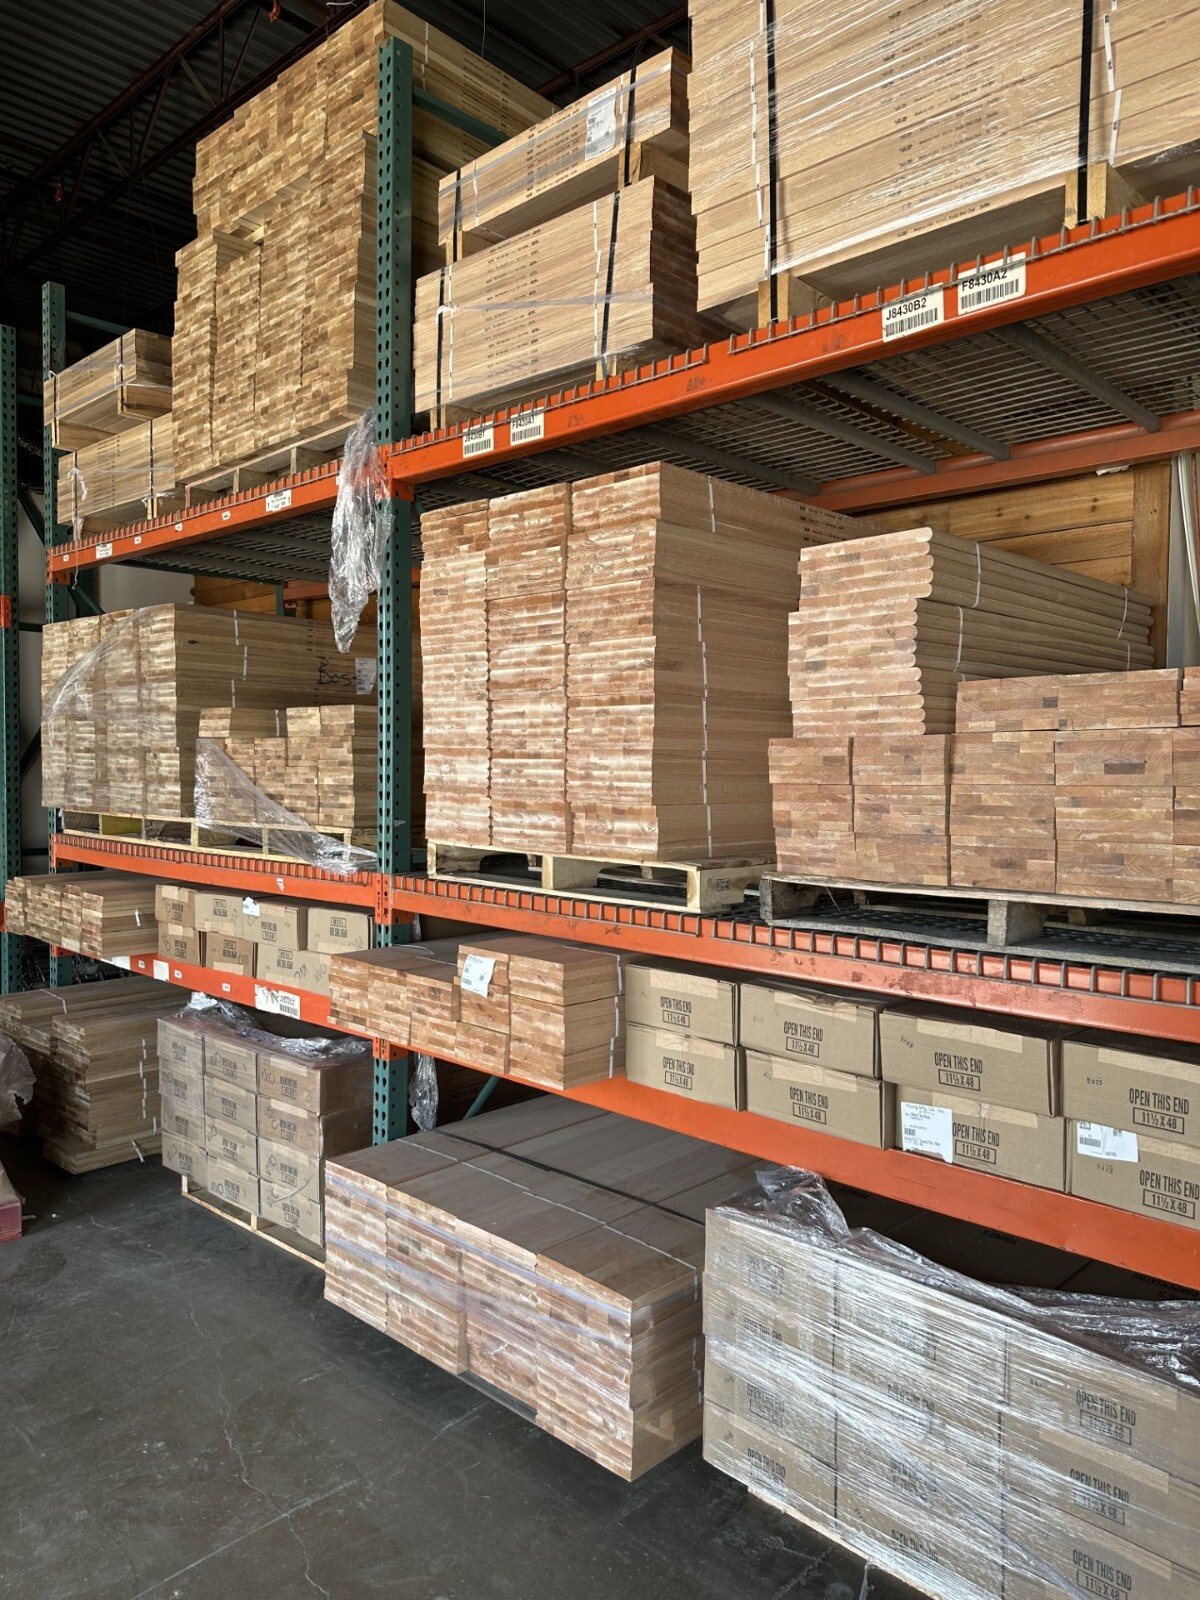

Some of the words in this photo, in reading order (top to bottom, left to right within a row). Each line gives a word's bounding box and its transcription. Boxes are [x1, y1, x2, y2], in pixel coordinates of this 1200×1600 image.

[961, 268, 1008, 292] F8430A2
[885, 297, 927, 321] J8430B2
[660, 996, 672, 1009] OPEN
[672, 998, 683, 1012] THIS
[683, 1000, 692, 1014] END
[784, 1020, 799, 1036] OPEN
[799, 1023, 811, 1039] THIS
[812, 1027, 823, 1042] END
[663, 1056, 676, 1070] OPEN
[676, 1058, 686, 1074] THIS
[686, 1061, 695, 1076] END
[934, 1052, 952, 1069] OPEN
[953, 1054, 969, 1072] THIS
[970, 1057, 983, 1074] END
[960, 1075, 965, 1085] X
[965, 1076, 974, 1087] 48
[789, 1086, 804, 1102] OPEN
[804, 1089, 817, 1106] THIS
[818, 1093, 829, 1109] END
[1129, 1087, 1151, 1107] OPEN
[1152, 1091, 1171, 1111] THIS
[1173, 1095, 1190, 1115] END
[952, 1121, 970, 1139] OPEN
[971, 1126, 986, 1143] THIS
[988, 1130, 1000, 1147] END
[1160, 1115, 1165, 1127] X
[1167, 1117, 1177, 1130] 48
[977, 1147, 982, 1157] X
[982, 1148, 991, 1160] 48
[1139, 1169, 1161, 1189] OPEN
[1162, 1175, 1182, 1195] THIS
[1184, 1180, 1200, 1200] END
[1170, 1198, 1176, 1210] X
[1177, 1201, 1187, 1214] 48
[1076, 1389, 1098, 1412] OPEN
[1098, 1397, 1118, 1419] THIS
[1120, 1405, 1136, 1426] END
[1070, 1468, 1091, 1488] OPEN
[1092, 1477, 1112, 1497] THIS
[1113, 1485, 1130, 1504] END
[1072, 1549, 1094, 1573] OPEN
[1095, 1559, 1114, 1582] THIS
[1116, 1569, 1132, 1591] END
